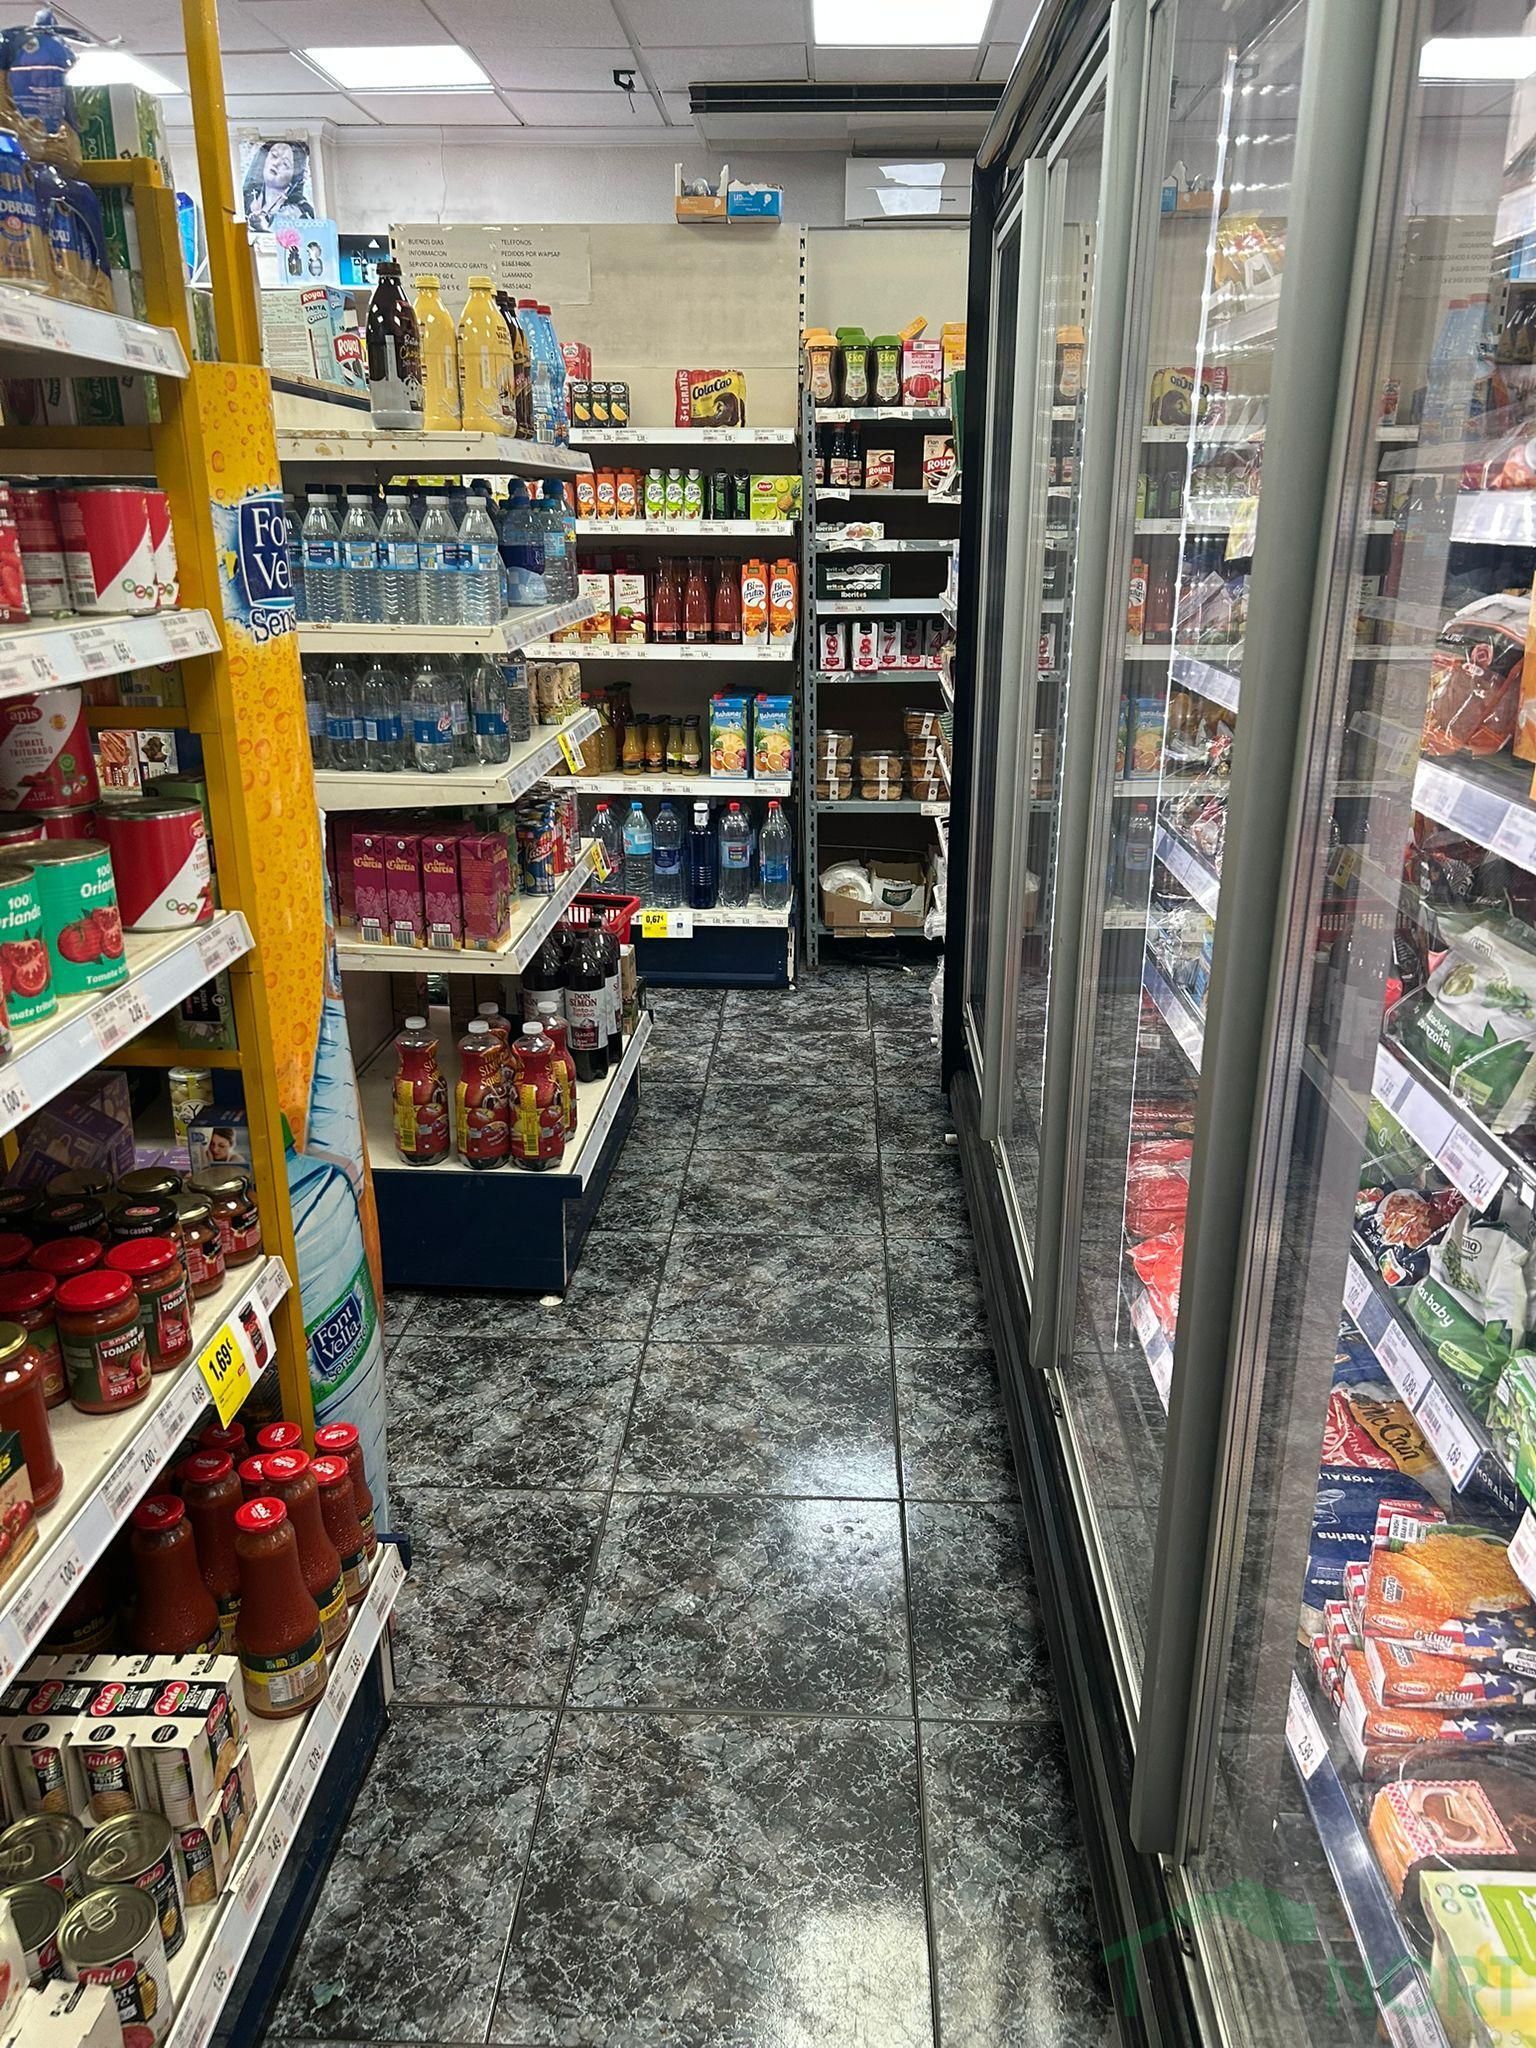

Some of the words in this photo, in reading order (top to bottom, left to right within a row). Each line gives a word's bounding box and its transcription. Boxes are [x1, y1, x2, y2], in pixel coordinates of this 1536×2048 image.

[408, 238, 431, 246] BUENOS
[408, 261, 434, 269] SERVICIO
[439, 262, 468, 270] DOMICILIO
[468, 262, 489, 270] GRATIS
[302, 290, 326, 303] Royal
[304, 305, 327, 313] TARTA
[337, 337, 361, 358] Royal
[848, 354, 864, 364] Eko
[879, 353, 896, 364] Eko
[679, 370, 690, 404] GRATIS
[692, 376, 733, 400] ColaCao
[868, 466, 891, 475] Royal
[746, 582, 755, 590] Bi
[774, 582, 783, 590] Bi
[826, 636, 839, 656] 9
[861, 638, 872, 654] 8
[884, 635, 896, 654] 7
[905, 632, 918, 650] 5
[930, 632, 944, 649] 4
[10, 707, 39, 723] apis
[714, 710, 742, 719] Bahamas
[759, 711, 787, 720] Bahamas
[14, 738, 45, 748] TOMATE
[9, 746, 54, 757] TRITURADO
[86, 970, 119, 985] Tomate
[569, 998, 598, 1007] SIMON
[574, 992, 591, 1000] DON
[129, 1225, 153, 1236] casero
[1426, 1296, 1456, 1327] baby
[316, 1306, 354, 1347] Font
[102, 1338, 139, 1359] TOMATE
[321, 1324, 361, 1366] Vella
[1476, 1466, 1515, 1512] MORALES
[1317, 1531, 1367, 1545] harina
[1413, 1629, 1453, 1647] Crispy
[97, 1687, 119, 1712] hida
[160, 1686, 181, 1711] hida
[1435, 1690, 1475, 1703] Crispy
[1297, 1735, 1313, 1762] 2,99
[87, 1755, 118, 1767] hida
[86, 1966, 130, 1986] hida
